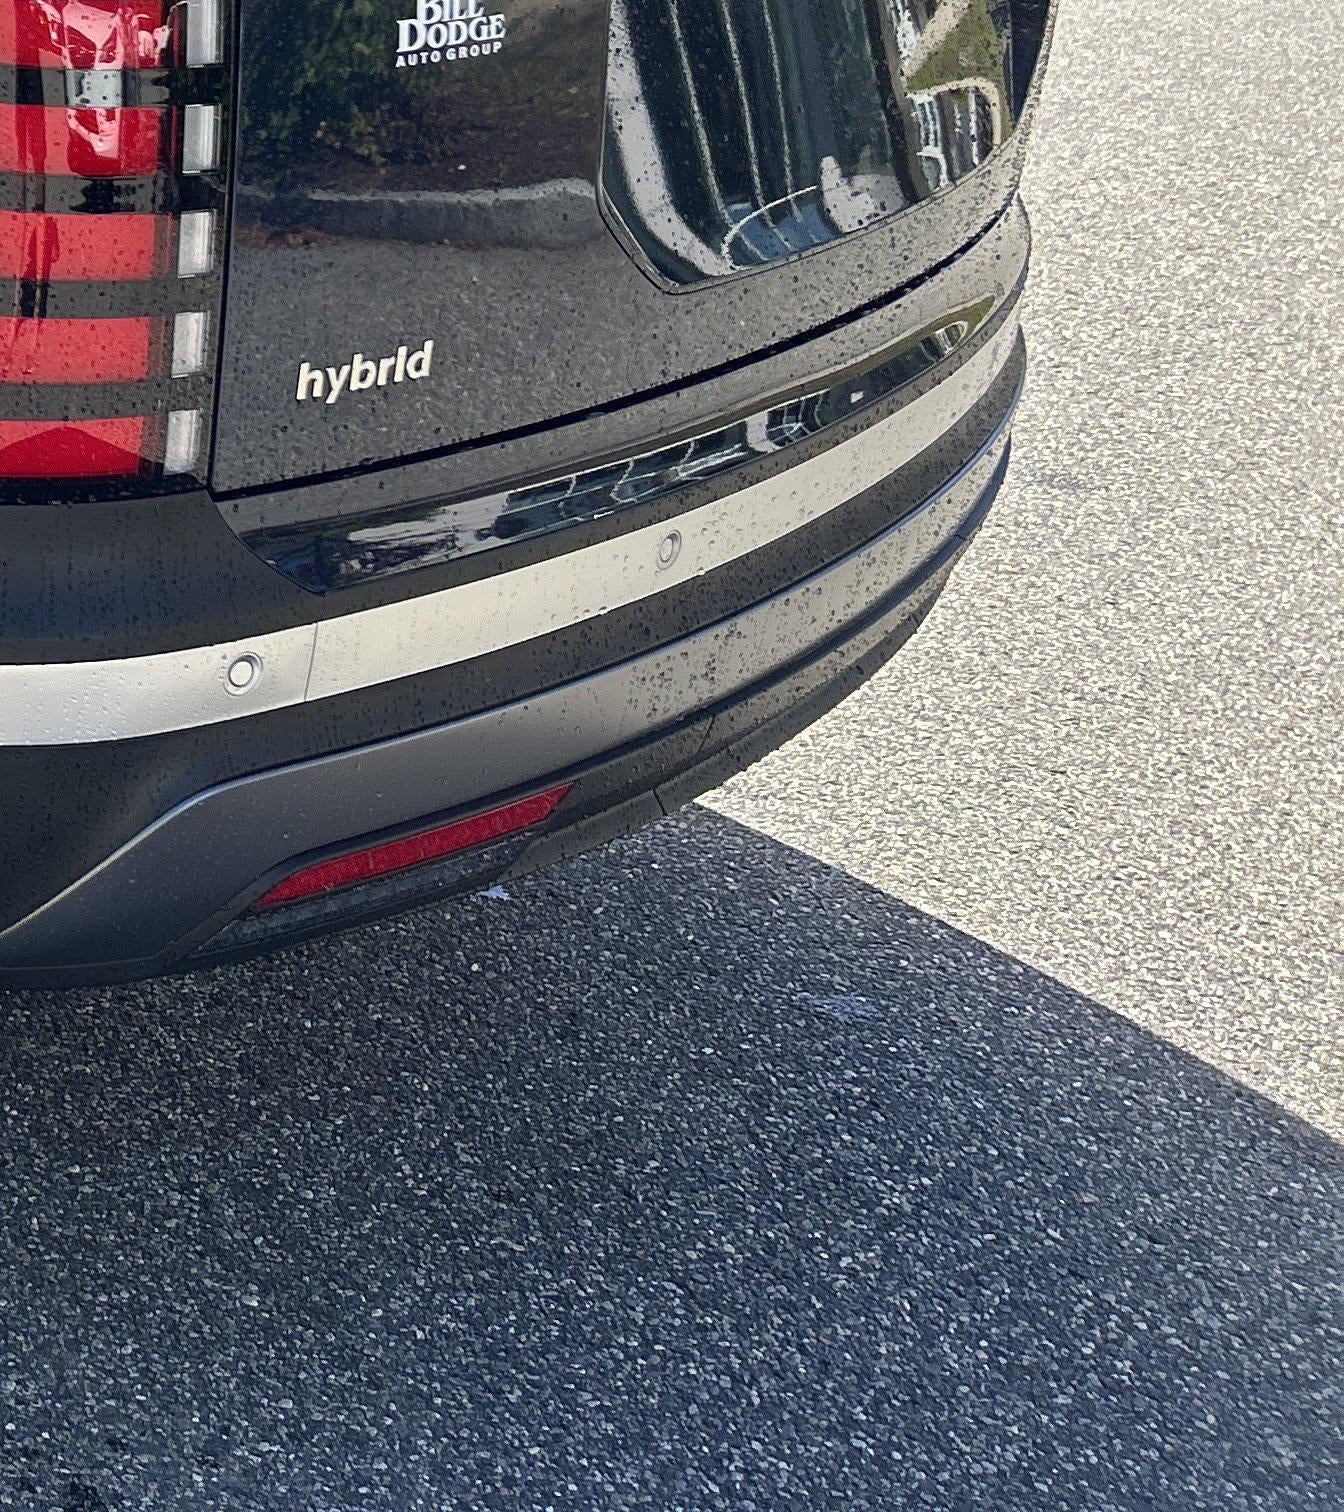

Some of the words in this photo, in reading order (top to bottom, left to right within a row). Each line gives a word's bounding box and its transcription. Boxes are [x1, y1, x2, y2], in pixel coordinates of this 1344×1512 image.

[396, 14, 506, 52] DODGE
[395, 50, 441, 67] AUTO
[446, 41, 502, 60] GROUP
[296, 340, 434, 404] hybrid
